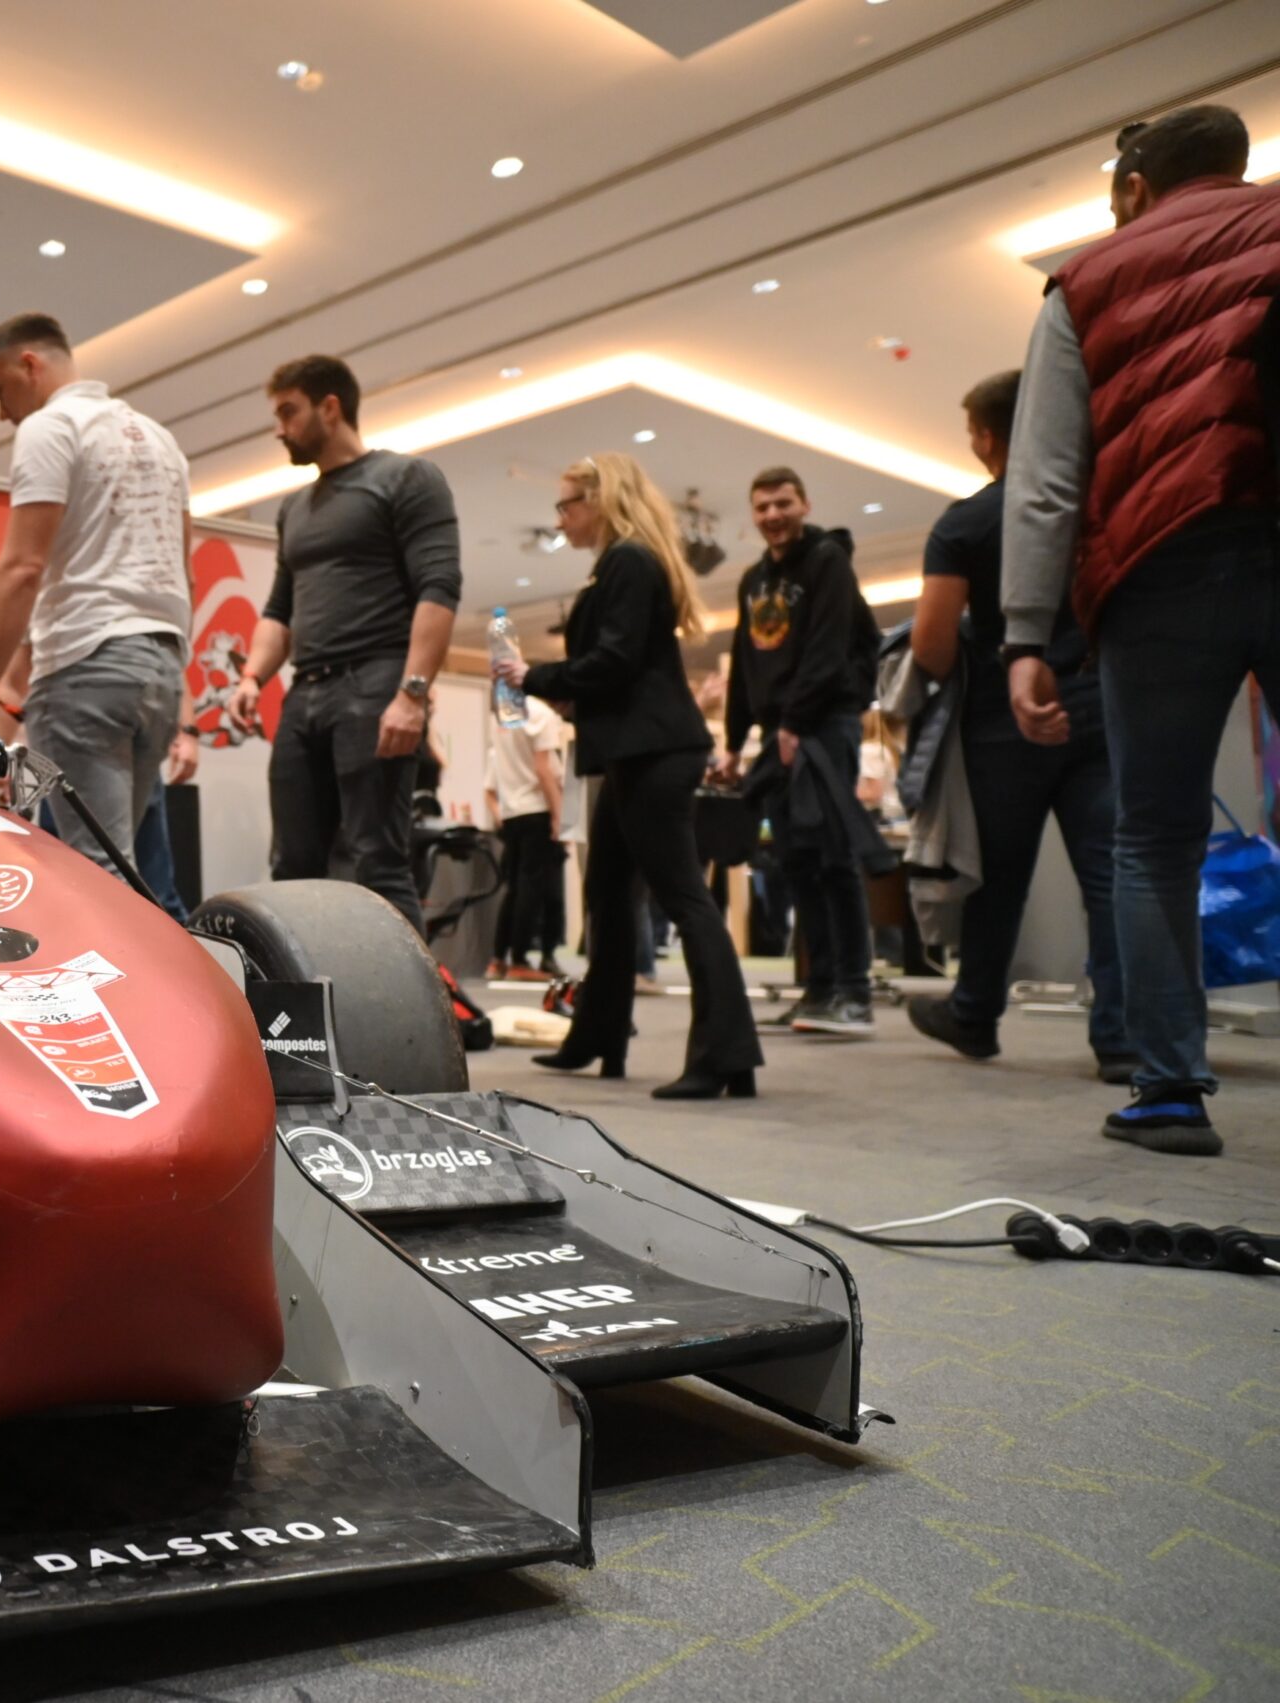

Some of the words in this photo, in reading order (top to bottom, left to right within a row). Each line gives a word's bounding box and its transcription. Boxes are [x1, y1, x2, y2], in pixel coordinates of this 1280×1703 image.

[370, 1145, 492, 1173] brzoglas
[494, 1285, 636, 1315] HEP
[33, 1516, 359, 1573] DALSTROJ
